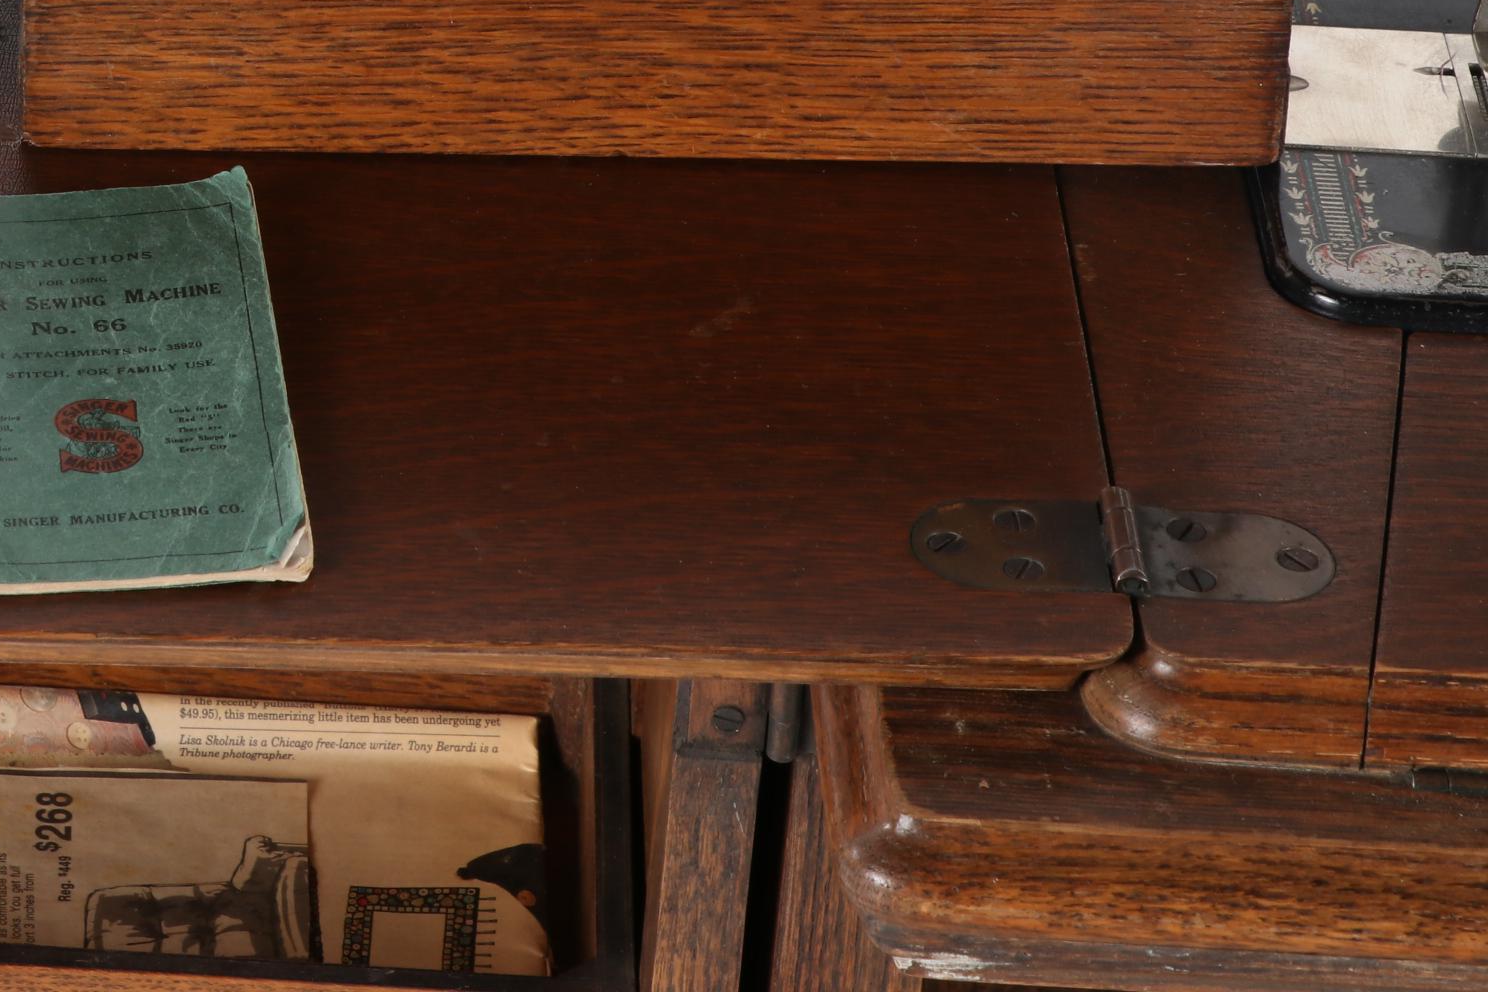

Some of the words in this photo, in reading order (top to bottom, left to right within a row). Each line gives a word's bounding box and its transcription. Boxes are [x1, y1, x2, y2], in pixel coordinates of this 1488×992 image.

[38, 278, 65, 287] FOR
[70, 276, 108, 285] USING
[25, 294, 107, 311] SEWING
[124, 282, 222, 304] MACHINE
[31, 321, 77, 336] No.
[93, 318, 128, 333] 66
[12, 348, 132, 360] ATTACHMENTS
[77, 368, 109, 377] FOR
[117, 362, 178, 376] FAMILY
[185, 358, 216, 370] USE
[3, 515, 60, 528] SINGER
[69, 505, 210, 526] MANUFACTURING
[218, 503, 246, 515] CO.
[179, 707, 223, 721] $49.95),
[224, 710, 245, 720] this
[247, 710, 315, 724] mesmerizing
[318, 710, 344, 723] little
[346, 712, 370, 724] item
[372, 712, 392, 724] has
[394, 713, 420, 725] been
[422, 714, 482, 729] undergoing
[484, 717, 502, 728] yet
[179, 734, 202, 746] Lisa
[205, 735, 246, 748] Skolnik
[248, 736, 259, 748] is
[261, 739, 268, 748] a
[271, 736, 314, 751] Chicago
[315, 737, 367, 751] free-lance
[369, 739, 404, 751] writer.
[408, 740, 433, 754] Tony
[436, 740, 477, 753] Berardi
[479, 742, 489, 754] is
[491, 745, 499, 754] a
[179, 747, 220, 759] Tribune
[221, 749, 296, 761] photographer.
[33, 792, 74, 853] $268
[11, 880, 24, 894] get
[23, 873, 35, 891] from
[58, 879, 75, 903] Reg.
[10, 896, 21, 913] You
[24, 894, 35, 920] inches
